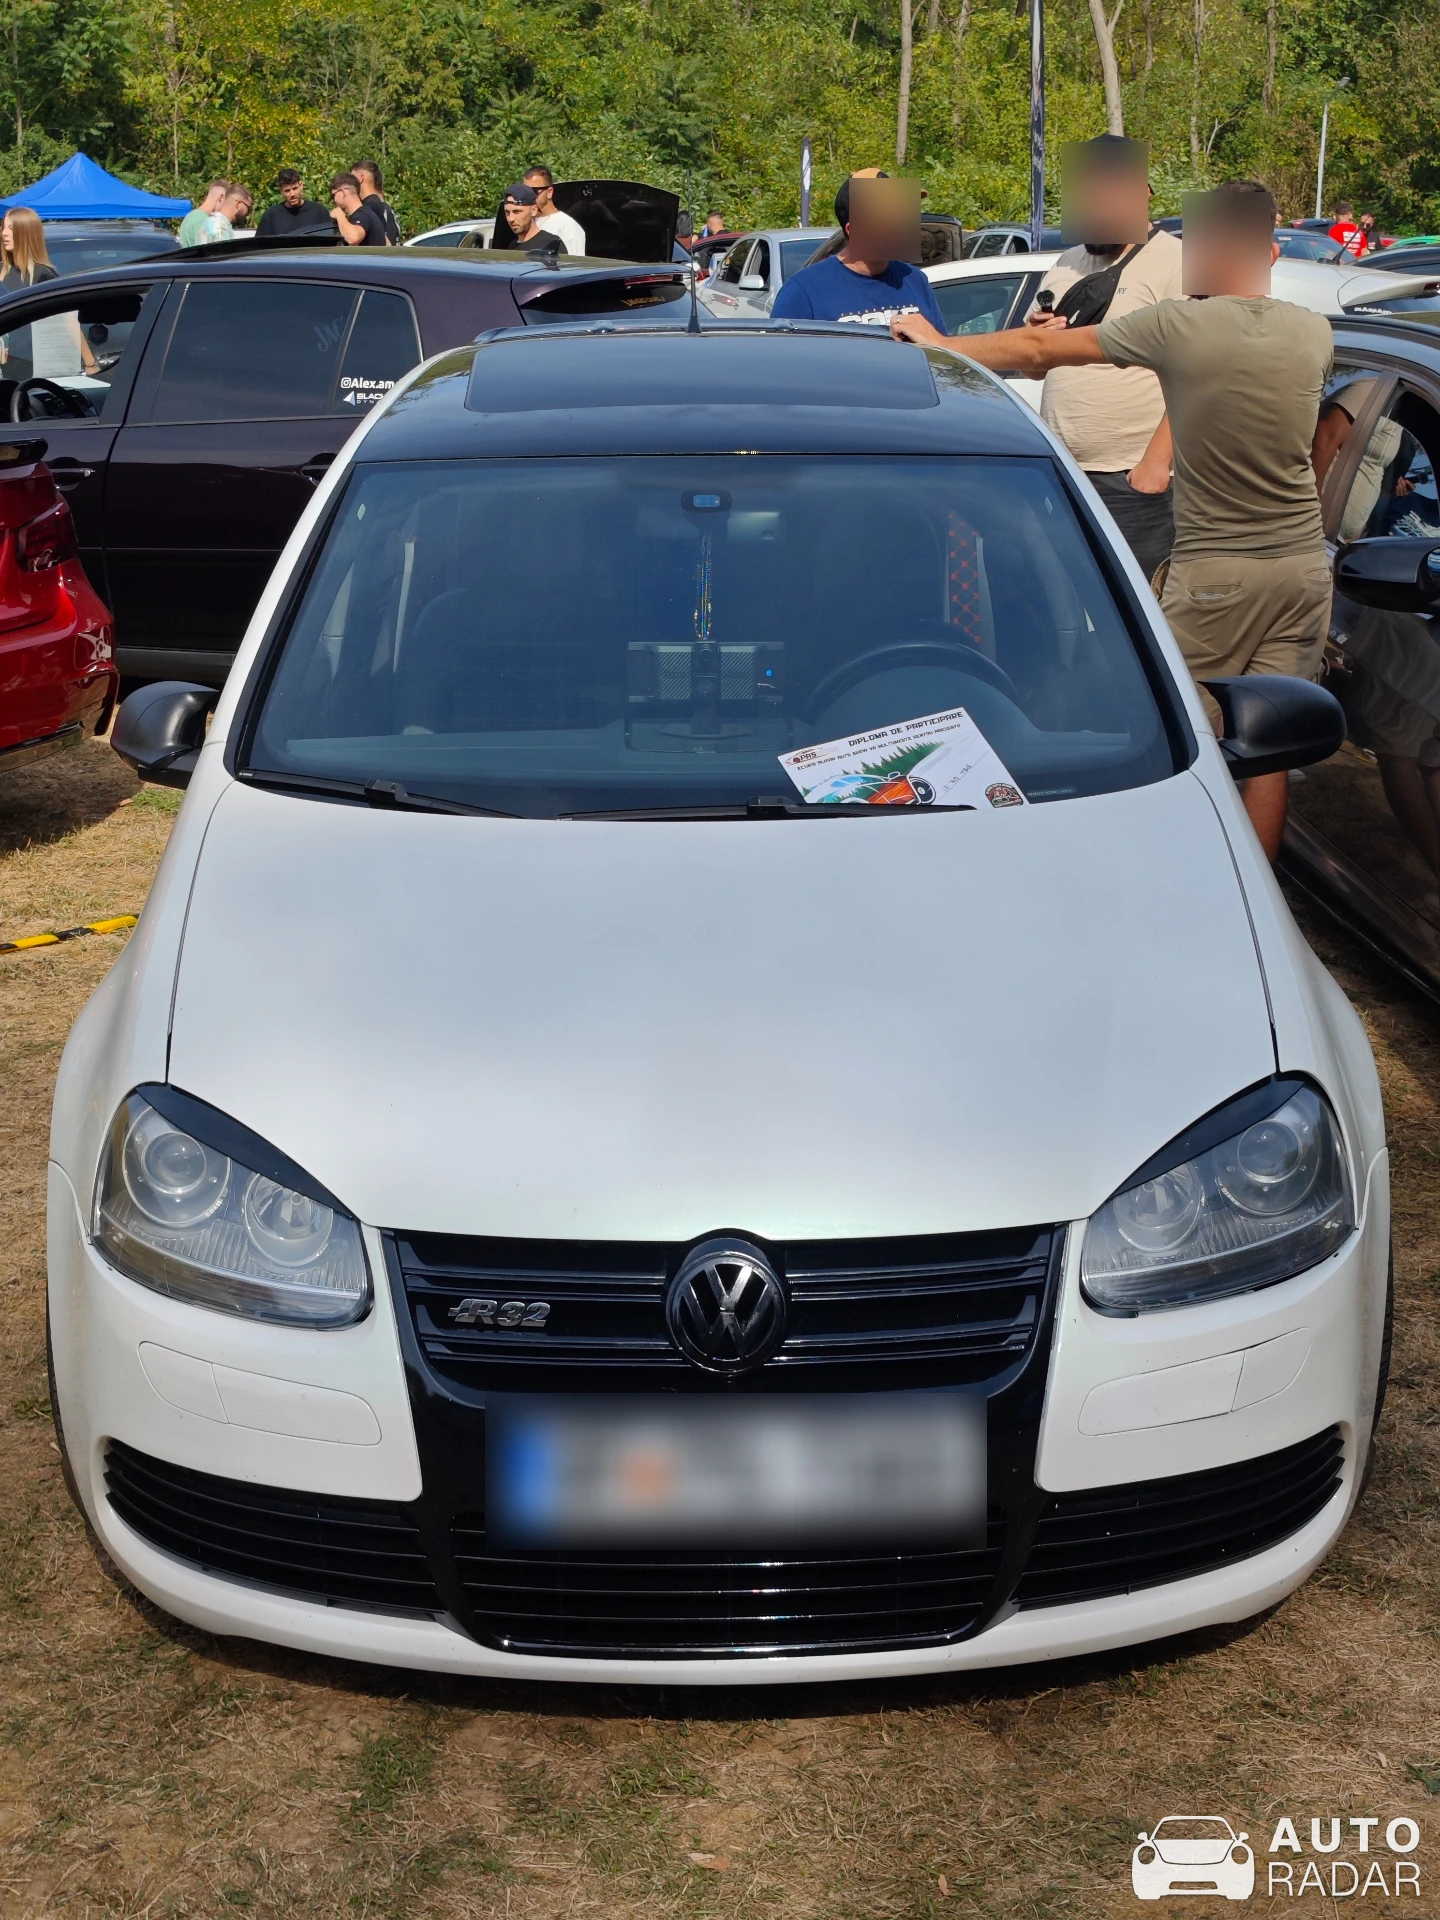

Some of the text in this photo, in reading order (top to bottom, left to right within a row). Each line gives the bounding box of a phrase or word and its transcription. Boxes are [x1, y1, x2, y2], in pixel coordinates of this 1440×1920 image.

[848, 712, 963, 746] DIPLOMA DE PARTICIPARE
[449, 1298, 551, 1328] R32
